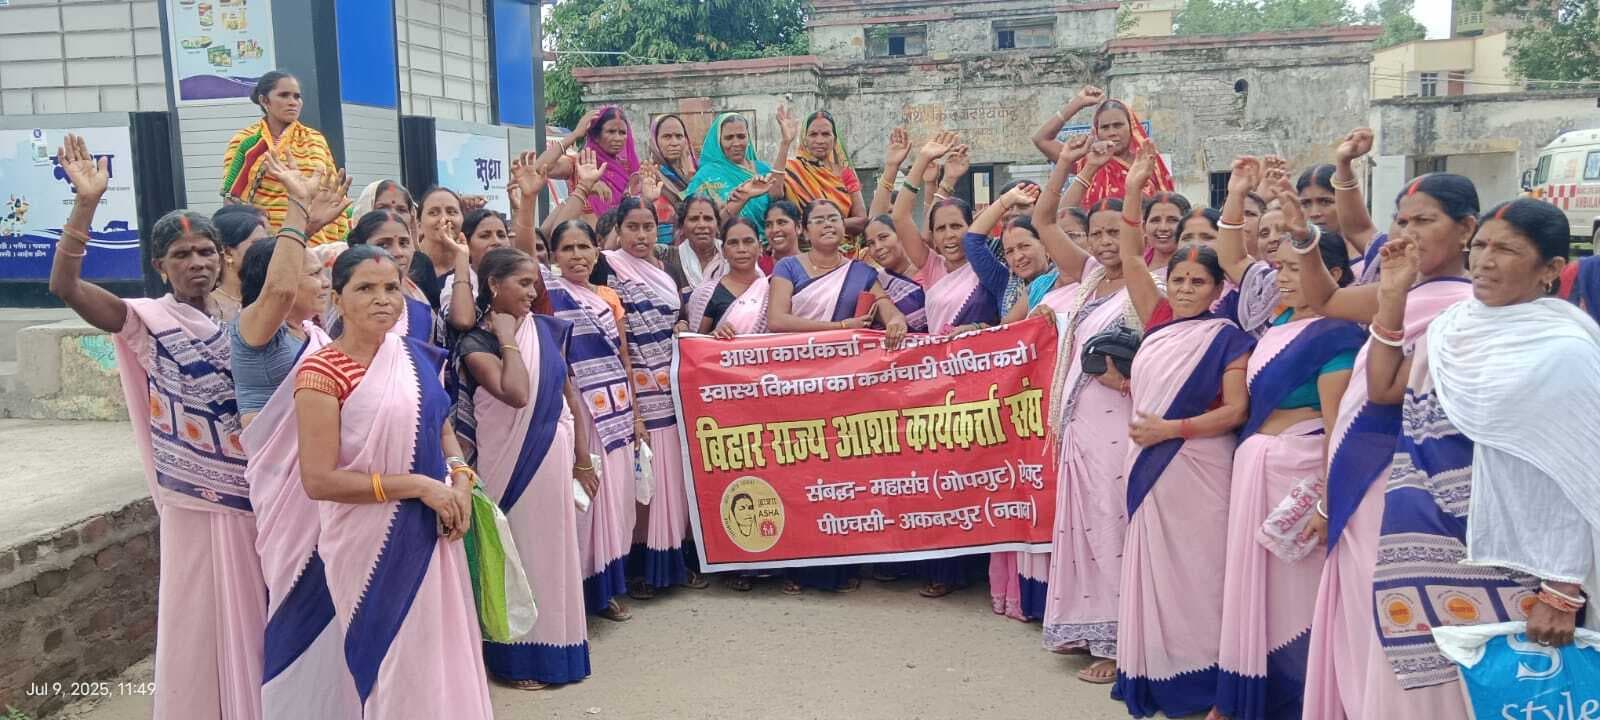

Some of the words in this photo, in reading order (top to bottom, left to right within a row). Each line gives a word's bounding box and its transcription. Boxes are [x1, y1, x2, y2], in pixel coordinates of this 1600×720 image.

[474, 158, 502, 191] सुधा
[720, 347, 769, 367] आशा
[761, 374, 824, 396] विभाग
[826, 375, 856, 392] का
[857, 356, 938, 386] कर्मचारी
[940, 349, 991, 376] घोषित
[696, 416, 766, 472] बिहार
[766, 419, 830, 465] राज्य
[832, 409, 901, 458] आशा
[1004, 376, 1045, 438] संघ
[869, 470, 929, 496] महासंघ
[932, 459, 1016, 499] (गोपगुट)
[758, 509, 780, 518] ASHA
[899, 505, 982, 530] अकबरपुर
